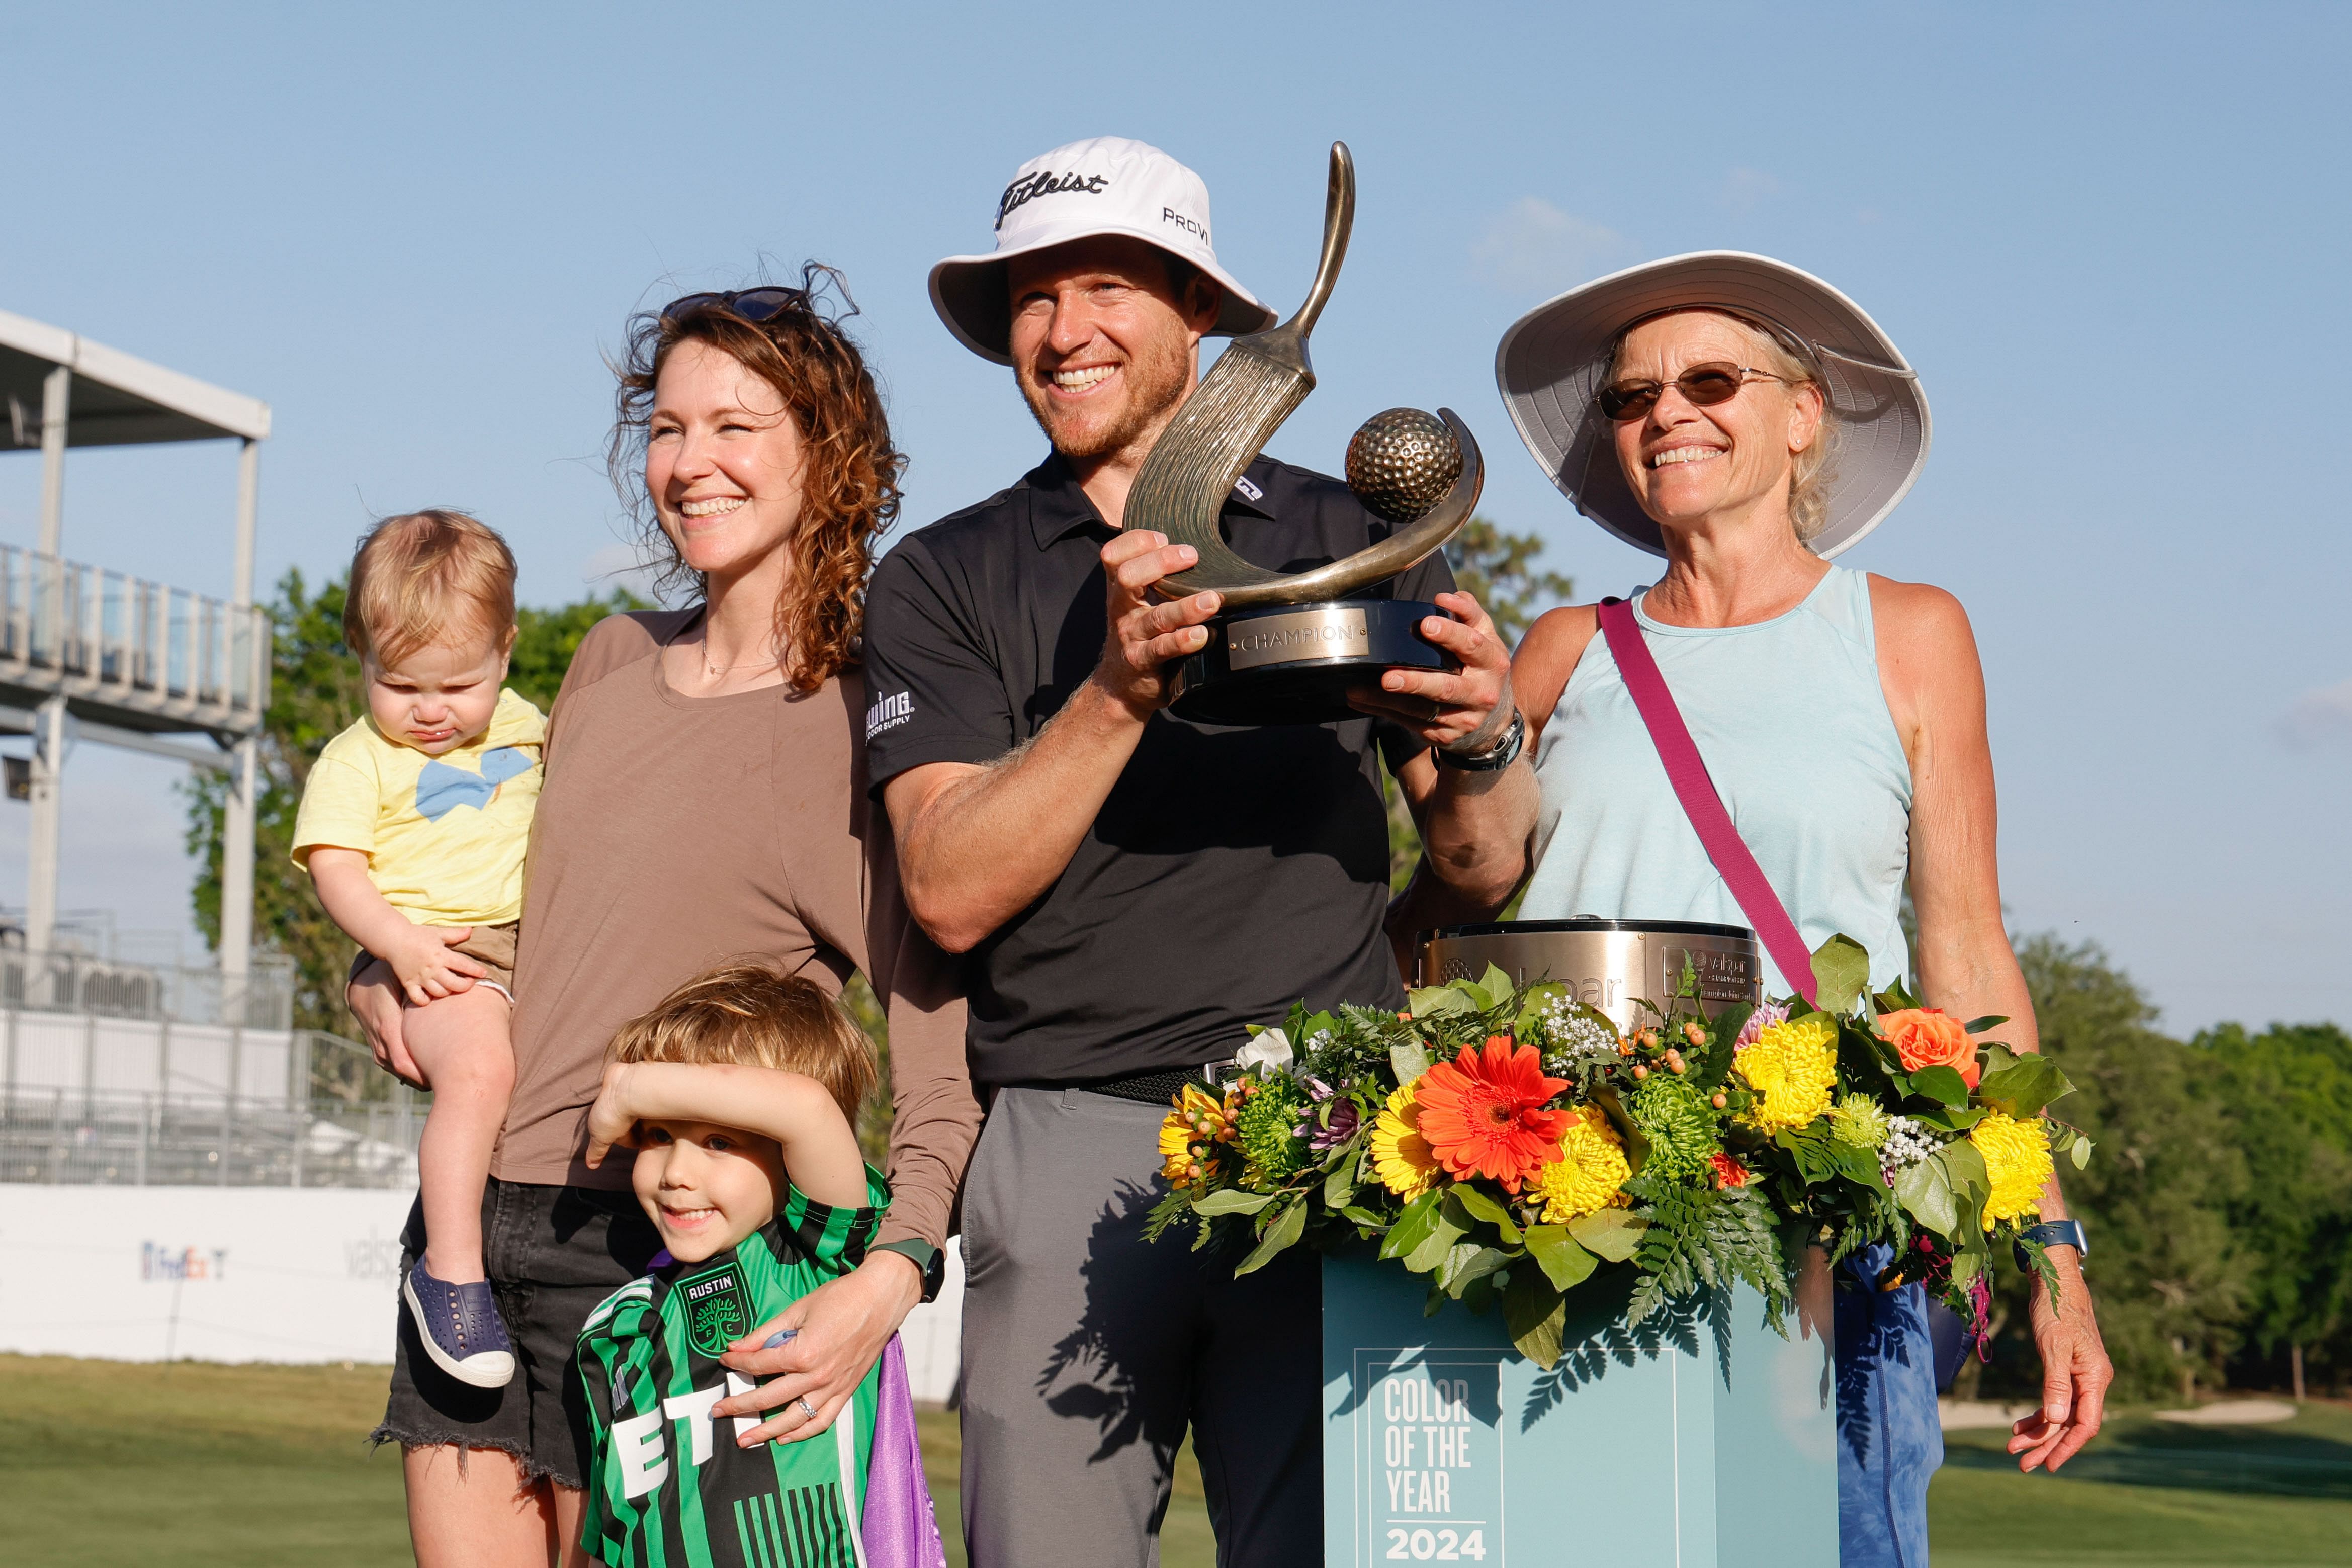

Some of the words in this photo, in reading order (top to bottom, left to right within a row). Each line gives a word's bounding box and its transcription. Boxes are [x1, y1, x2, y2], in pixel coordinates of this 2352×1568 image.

[995, 171, 1109, 230] Titleist
[1241, 625, 1354, 651] CHAMPION
[883, 715, 910, 730] SUPPLY
[689, 1276, 732, 1299] AUSTIN
[706, 1329, 712, 1337] F
[726, 1324, 733, 1332] C
[1385, 1379, 1470, 1422] COLOR
[1385, 1425, 1416, 1467] OF
[1423, 1426, 1471, 1468] THE
[1386, 1471, 1451, 1513] YEAR
[1386, 1528, 1487, 1561] 2024
